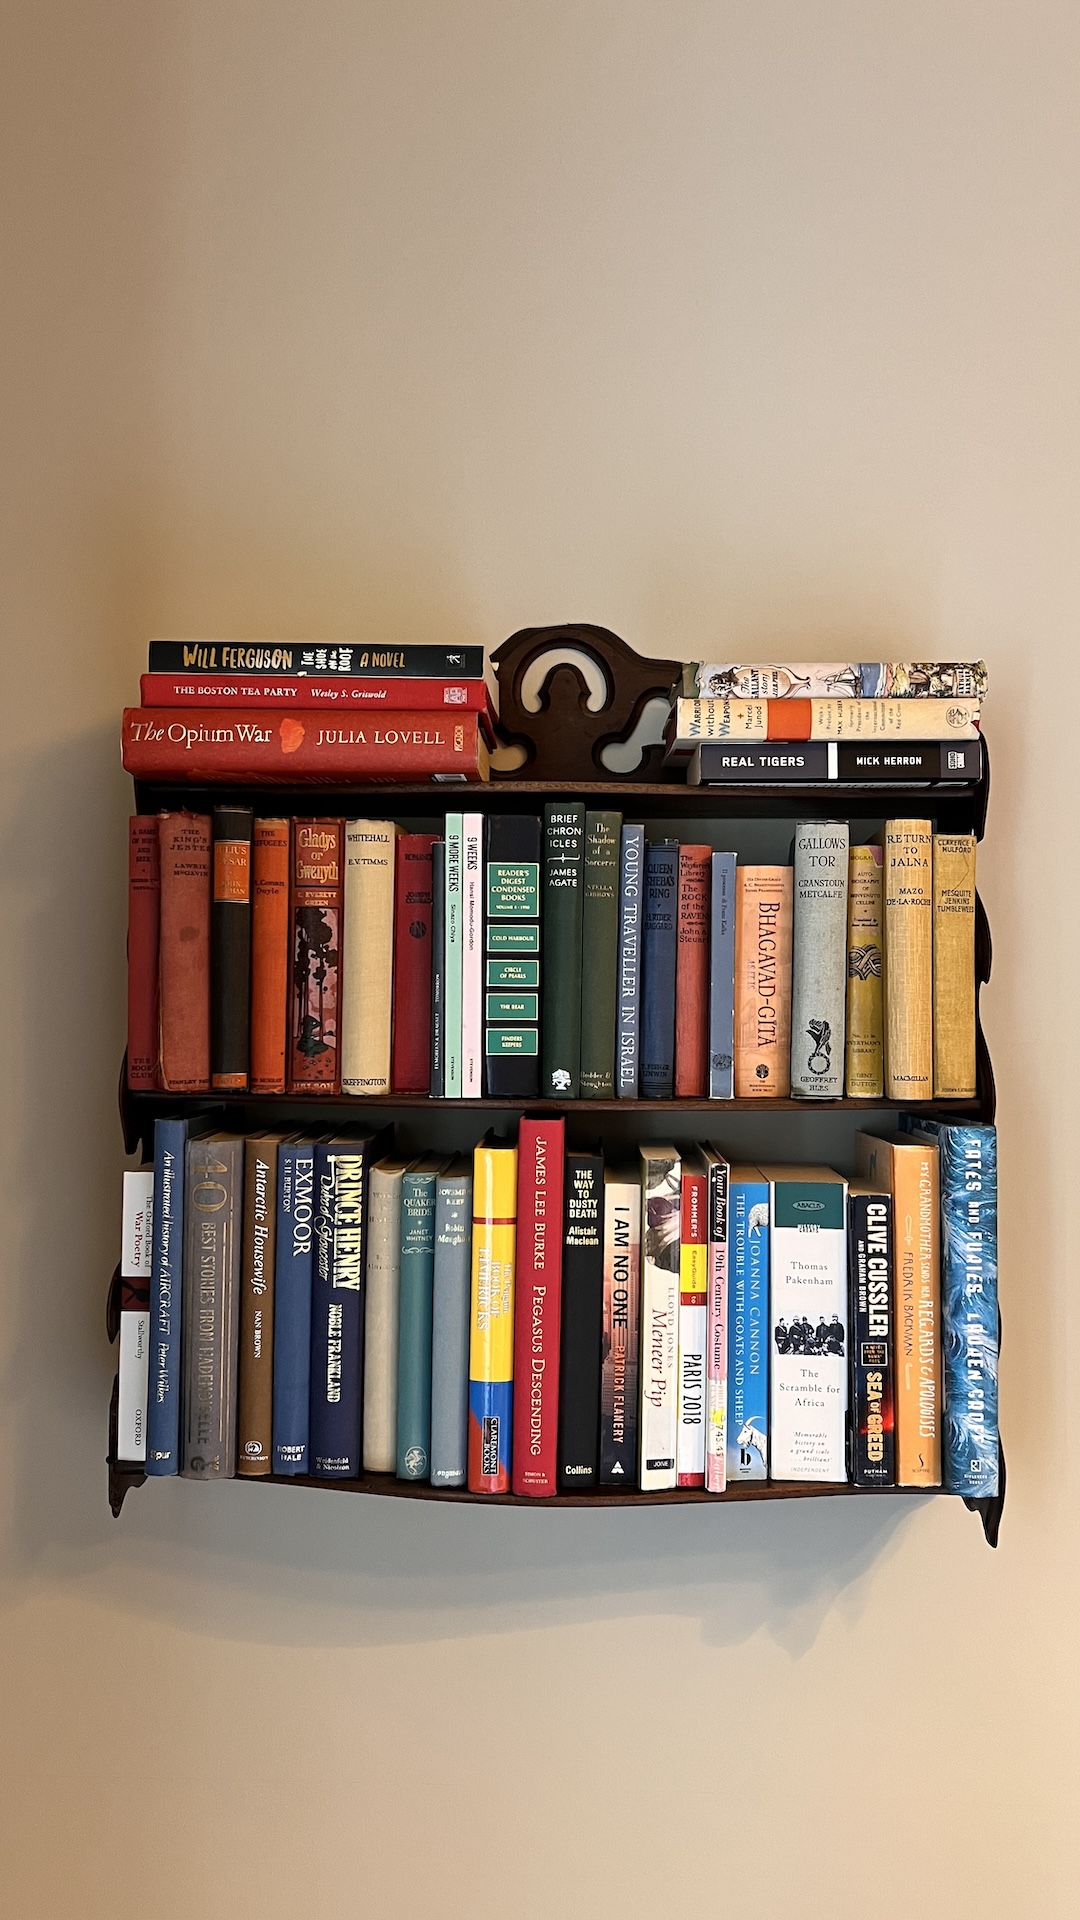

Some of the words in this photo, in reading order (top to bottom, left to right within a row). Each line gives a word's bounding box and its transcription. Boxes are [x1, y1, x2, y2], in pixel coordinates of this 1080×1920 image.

[183, 644, 220, 668] WILL
[222, 646, 293, 670] FERGUSON
[360, 652, 369, 668] A
[372, 652, 405, 668] NOVEL
[173, 686, 195, 695] THE
[197, 686, 238, 696] BOSTON
[240, 687, 261, 696] TEA
[263, 687, 297, 697] PARTY
[310, 689, 338, 699] Wesley
[340, 689, 348, 698] S.
[351, 689, 386, 699] Griswold
[706, 700, 714, 736] without
[755, 706, 763, 728] Junod
[130, 721, 165, 742] The
[168, 723, 233, 751] Opium
[234, 723, 272, 742] War
[316, 730, 367, 745] JULIA
[374, 730, 445, 745] LOVELL
[722, 757, 756, 766] REAL
[759, 757, 804, 767] TIGERS
[856, 757, 880, 765] MICK
[884, 757, 922, 765] HERRON
[550, 815, 578, 823] BRIEF
[298, 828, 336, 852] Gladys
[347, 834, 390, 843] WHITEHALL
[550, 839, 577, 848] ICLES
[798, 838, 845, 849] GALLOWS
[311, 852, 323, 860] or
[361, 858, 388, 866] TIMMS
[449, 842, 459, 864] MORE
[585, 858, 616, 866] Sorcerer
[624, 836, 639, 896] YOUNG
[809, 855, 835, 867] TOR
[891, 858, 929, 867] JALNA
[297, 861, 339, 884] Gwenyth
[449, 865, 459, 892] WEEKS
[549, 868, 577, 877] JAMES
[549, 878, 577, 887] AGATE
[257, 887, 279, 895] Doyle
[649, 889, 670, 898] RING
[681, 884, 698, 892] The
[799, 890, 843, 898] METCALFE
[622, 904, 637, 997] TRAVELLER
[622, 1007, 635, 1023] IN
[620, 1031, 635, 1087] ISRAEL
[535, 1136, 548, 1185] JAMES
[920, 1161, 929, 1176] MY
[574, 1180, 594, 1189] WAY
[575, 1170, 592, 1179] THE
[253, 1158, 270, 1220] Antarctic
[326, 1154, 363, 1225] PRINCE
[413, 1188, 428, 1197] The
[578, 1190, 589, 1198] TO
[292, 1158, 314, 1256] EXMOOR
[404, 1199, 435, 1207] QUAKER
[534, 1190, 546, 1216] LEE
[569, 1199, 598, 1208] DUSTY
[569, 1209, 597, 1218] DEATH
[690, 1185, 699, 1238] FROMMER'S
[715, 1197, 726, 1222] Book
[735, 1193, 745, 1218] THE
[134, 1212, 144, 1230] War
[569, 1226, 597, 1235] Alistair
[614, 1219, 629, 1246] AM
[867, 1202, 888, 1252] CLIVE
[919, 1179, 932, 1260] GRANDMOTHER
[132, 1232, 143, 1267] Poetry
[251, 1224, 268, 1294] Housewife
[331, 1227, 361, 1290] HENRY
[534, 1222, 546, 1269] BURKE
[735, 1220, 745, 1276] TROUBLE
[613, 1255, 629, 1282] NO
[690, 1250, 698, 1289] EasyGuide
[715, 1248, 725, 1272] 19th
[748, 1239, 761, 1300] JOANNA
[790, 1261, 828, 1272] Thomas
[858, 1252, 866, 1282] GRAHAM
[785, 1275, 833, 1286] Pakenham
[903, 1251, 914, 1299] FREDRIK
[158, 1268, 171, 1334] AIRCRAFT
[613, 1289, 628, 1329] ONE
[667, 1287, 675, 1325] LLOYD
[713, 1276, 725, 1318] Century
[735, 1279, 745, 1313] WITH
[858, 1285, 867, 1312] BROWN
[868, 1257, 890, 1335] CUSSLER
[254, 1311, 262, 1327] NAN
[328, 1304, 342, 1336] NOBLE
[532, 1285, 546, 1353] PEGASUS
[735, 1316, 745, 1349] GOATS
[903, 1304, 914, 1355] BACKMAN
[919, 1299, 934, 1364] REGARDS
[135, 1320, 144, 1359] Stallworthy
[651, 1309, 668, 1374] Meneer
[713, 1323, 724, 1370] Costume
[750, 1306, 760, 1375] CANNON
[326, 1339, 342, 1402] FRANKLAND
[614, 1346, 626, 1391] PATRICK
[683, 1354, 702, 1390] PARIS
[735, 1353, 745, 1386] AND
[800, 1369, 819, 1378] The
[645, 1378, 666, 1407] Pip
[779, 1383, 822, 1393] Scramble
[826, 1384, 840, 1394] for
[867, 1371, 882, 1398] SEA
[530, 1358, 545, 1455] DESCENDING
[683, 1395, 703, 1425] 2018
[734, 1389, 745, 1425] SHEEP
[794, 1397, 825, 1408] Africa
[919, 1377, 935, 1437] APOLOGISES
[134, 1409, 142, 1445] OXFORD
[613, 1395, 625, 1443] FLANERY
[490, 1418, 498, 1473] CLAREMONT
[867, 1413, 883, 1460] GREED
[565, 1465, 593, 1475] Collins
